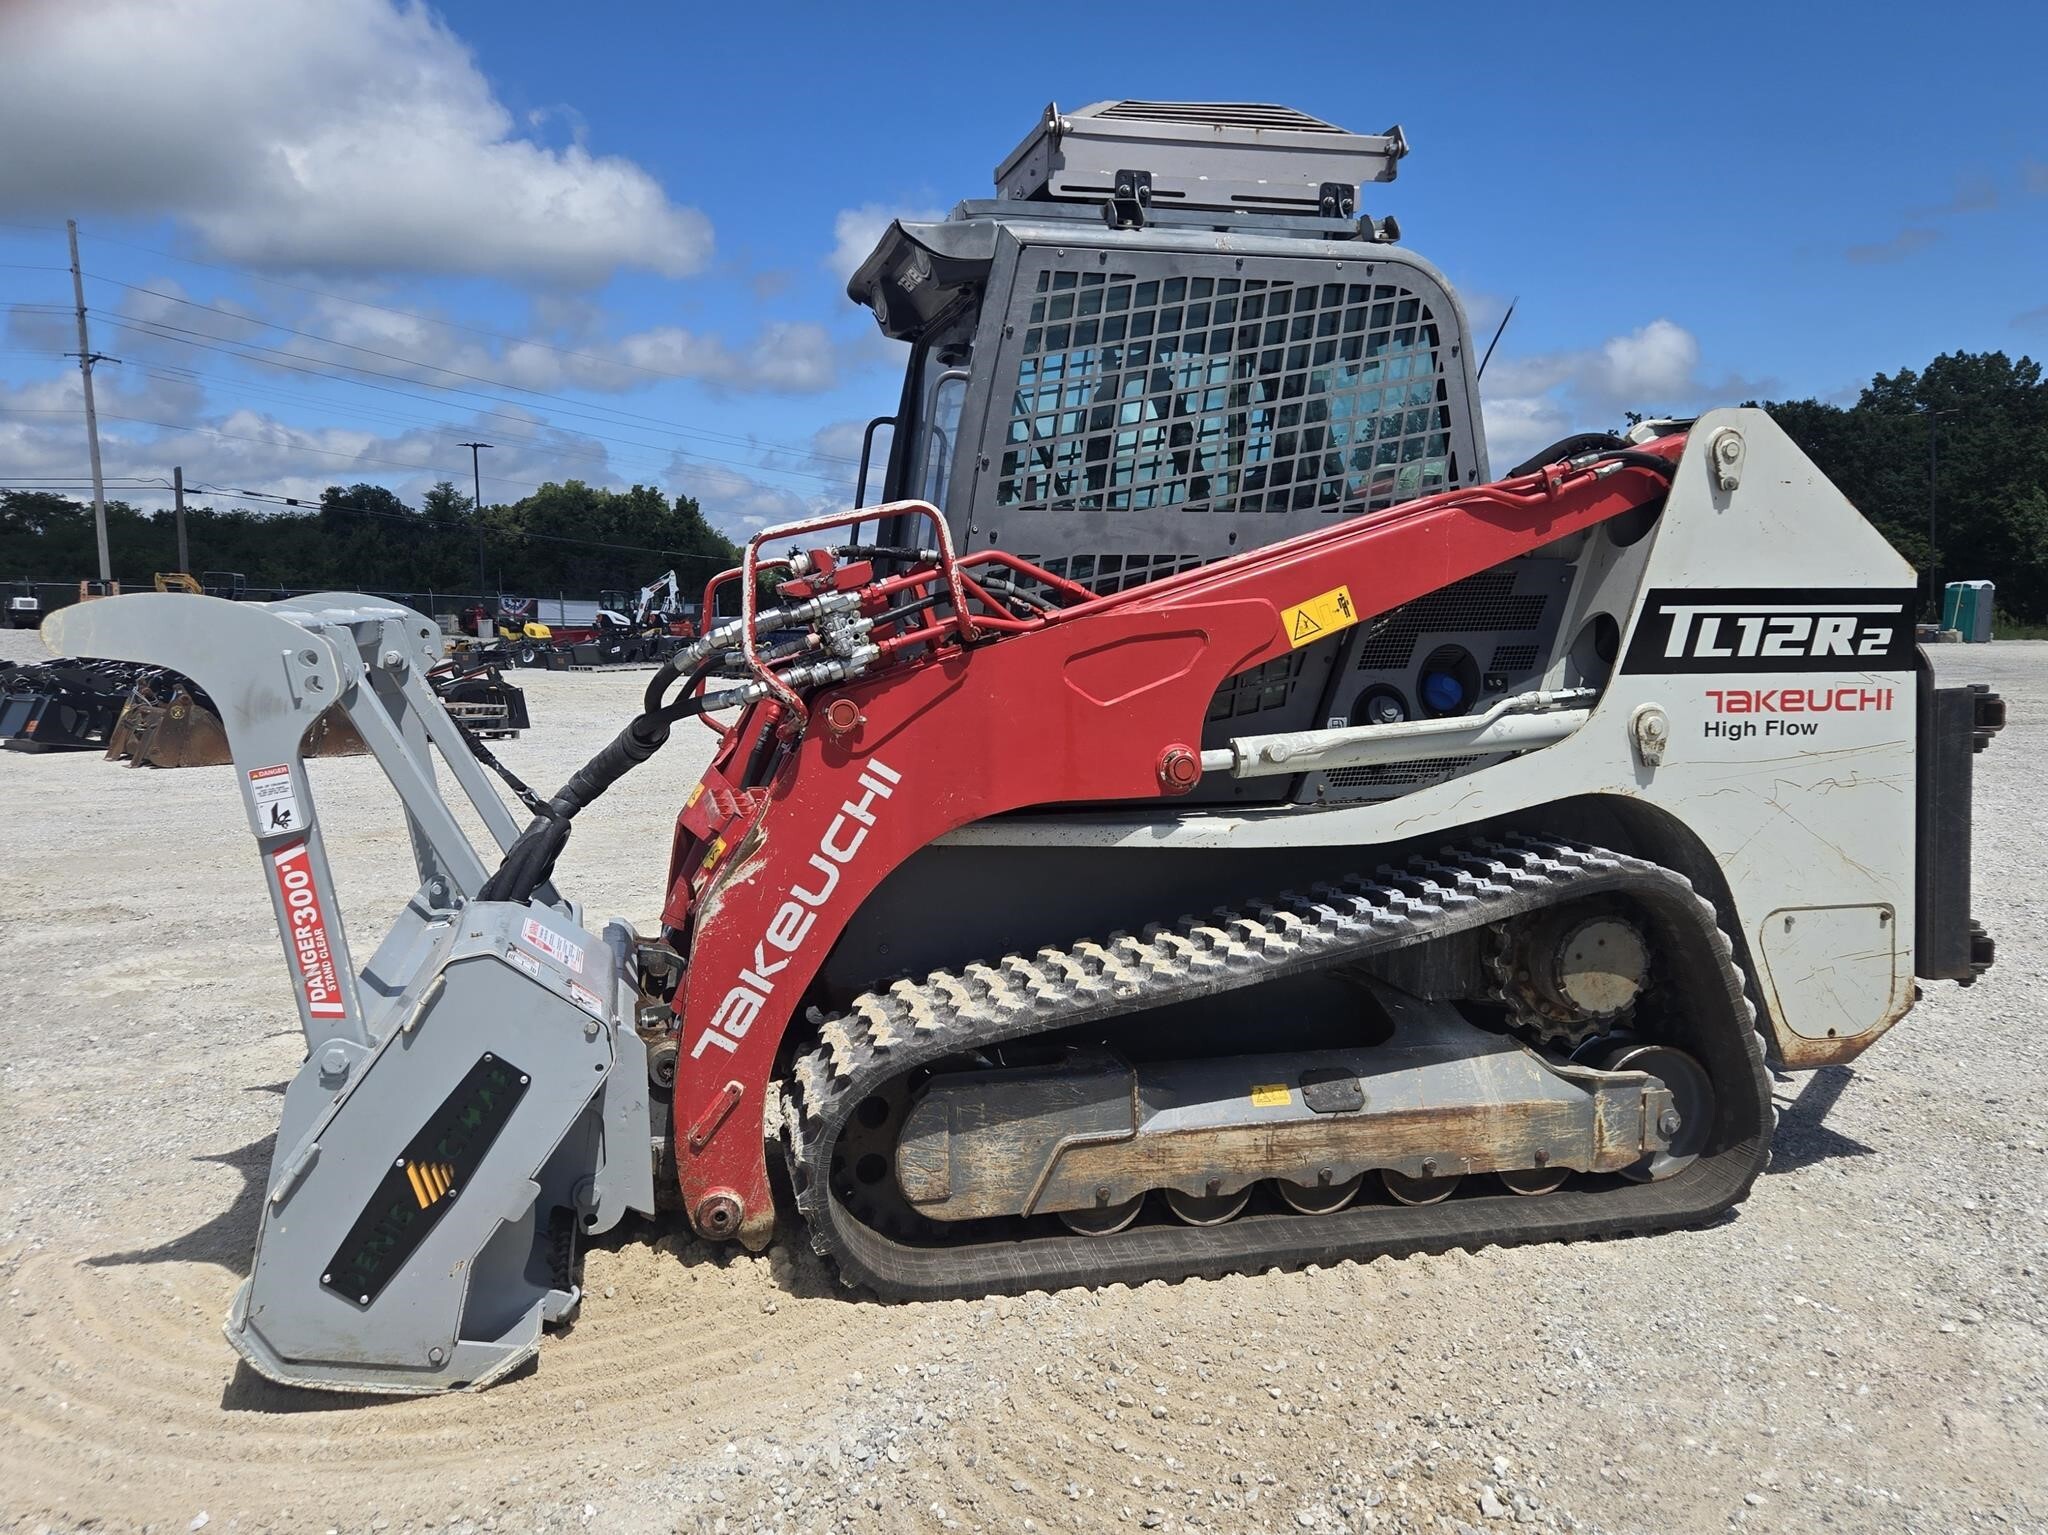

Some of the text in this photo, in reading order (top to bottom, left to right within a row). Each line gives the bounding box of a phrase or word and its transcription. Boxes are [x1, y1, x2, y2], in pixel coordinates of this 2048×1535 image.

[1658, 604, 1904, 658] TL12R2
[1704, 720, 1819, 741] High Flow
[258, 766, 288, 777] DANGER
[295, 925, 327, 1002] DANGER
[314, 927, 337, 992] STAND CLEAR
